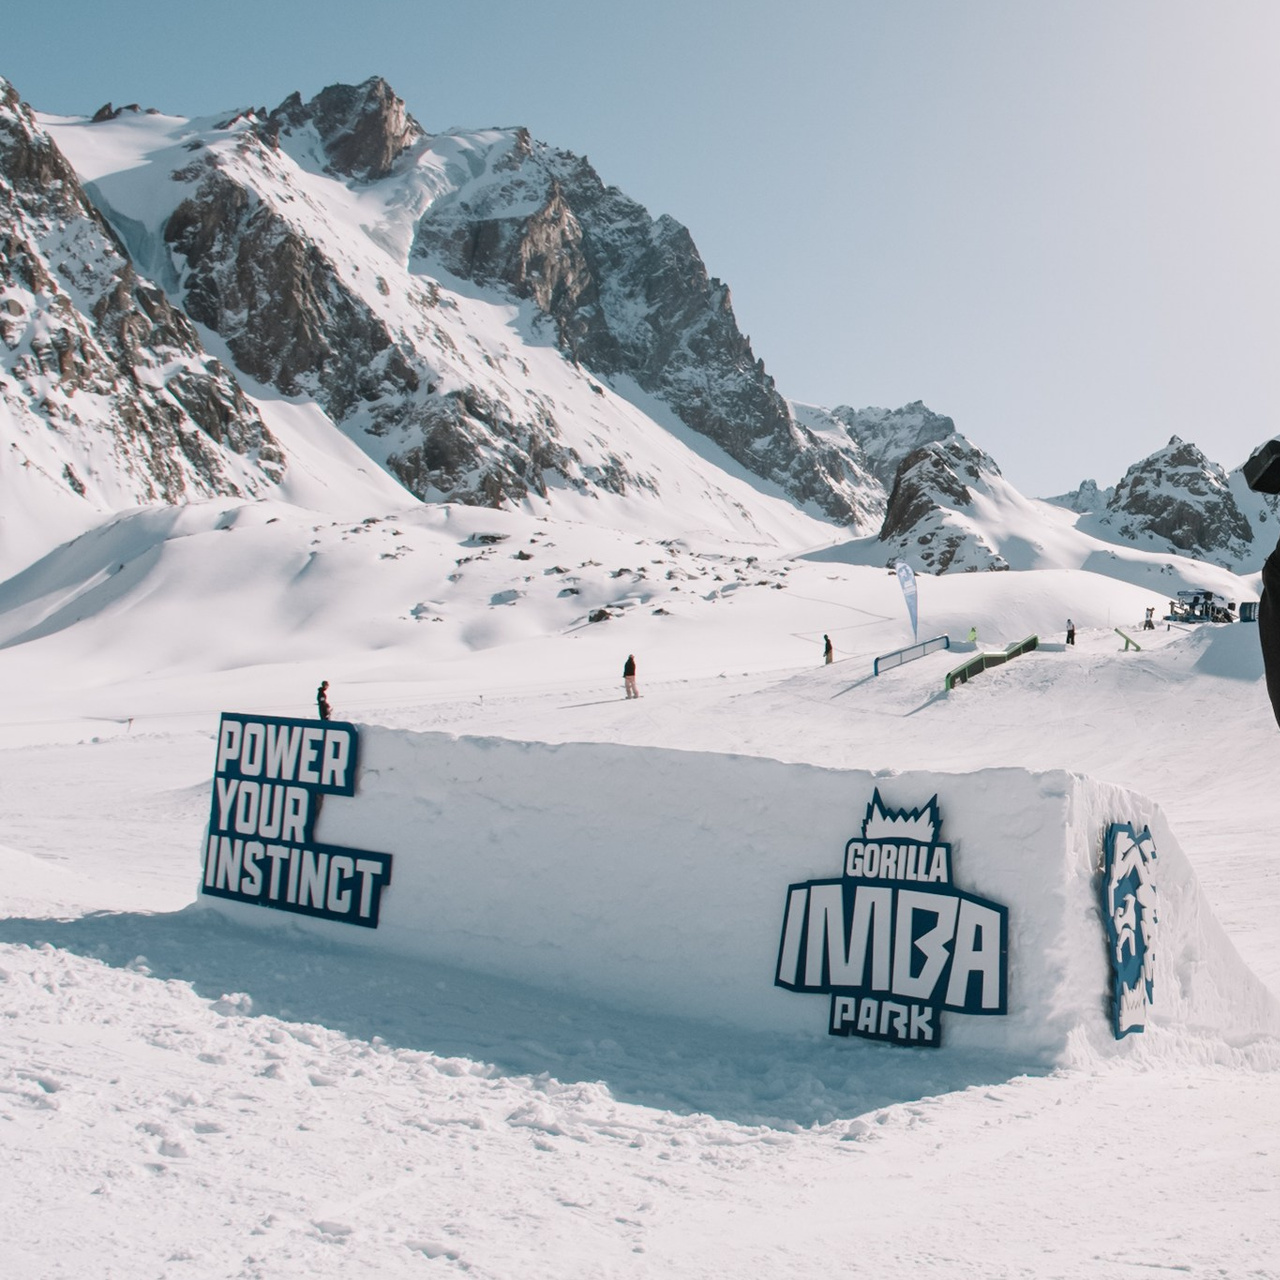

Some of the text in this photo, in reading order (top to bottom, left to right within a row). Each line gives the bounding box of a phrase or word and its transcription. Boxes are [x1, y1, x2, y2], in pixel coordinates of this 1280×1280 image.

[217, 720, 351, 787] POWER
[216, 776, 309, 843] YOUR
[205, 834, 383, 918] INSTINCT
[846, 842, 948, 883] GORILLA
[779, 884, 1001, 1009] IMBA
[833, 996, 933, 1040] PARK
